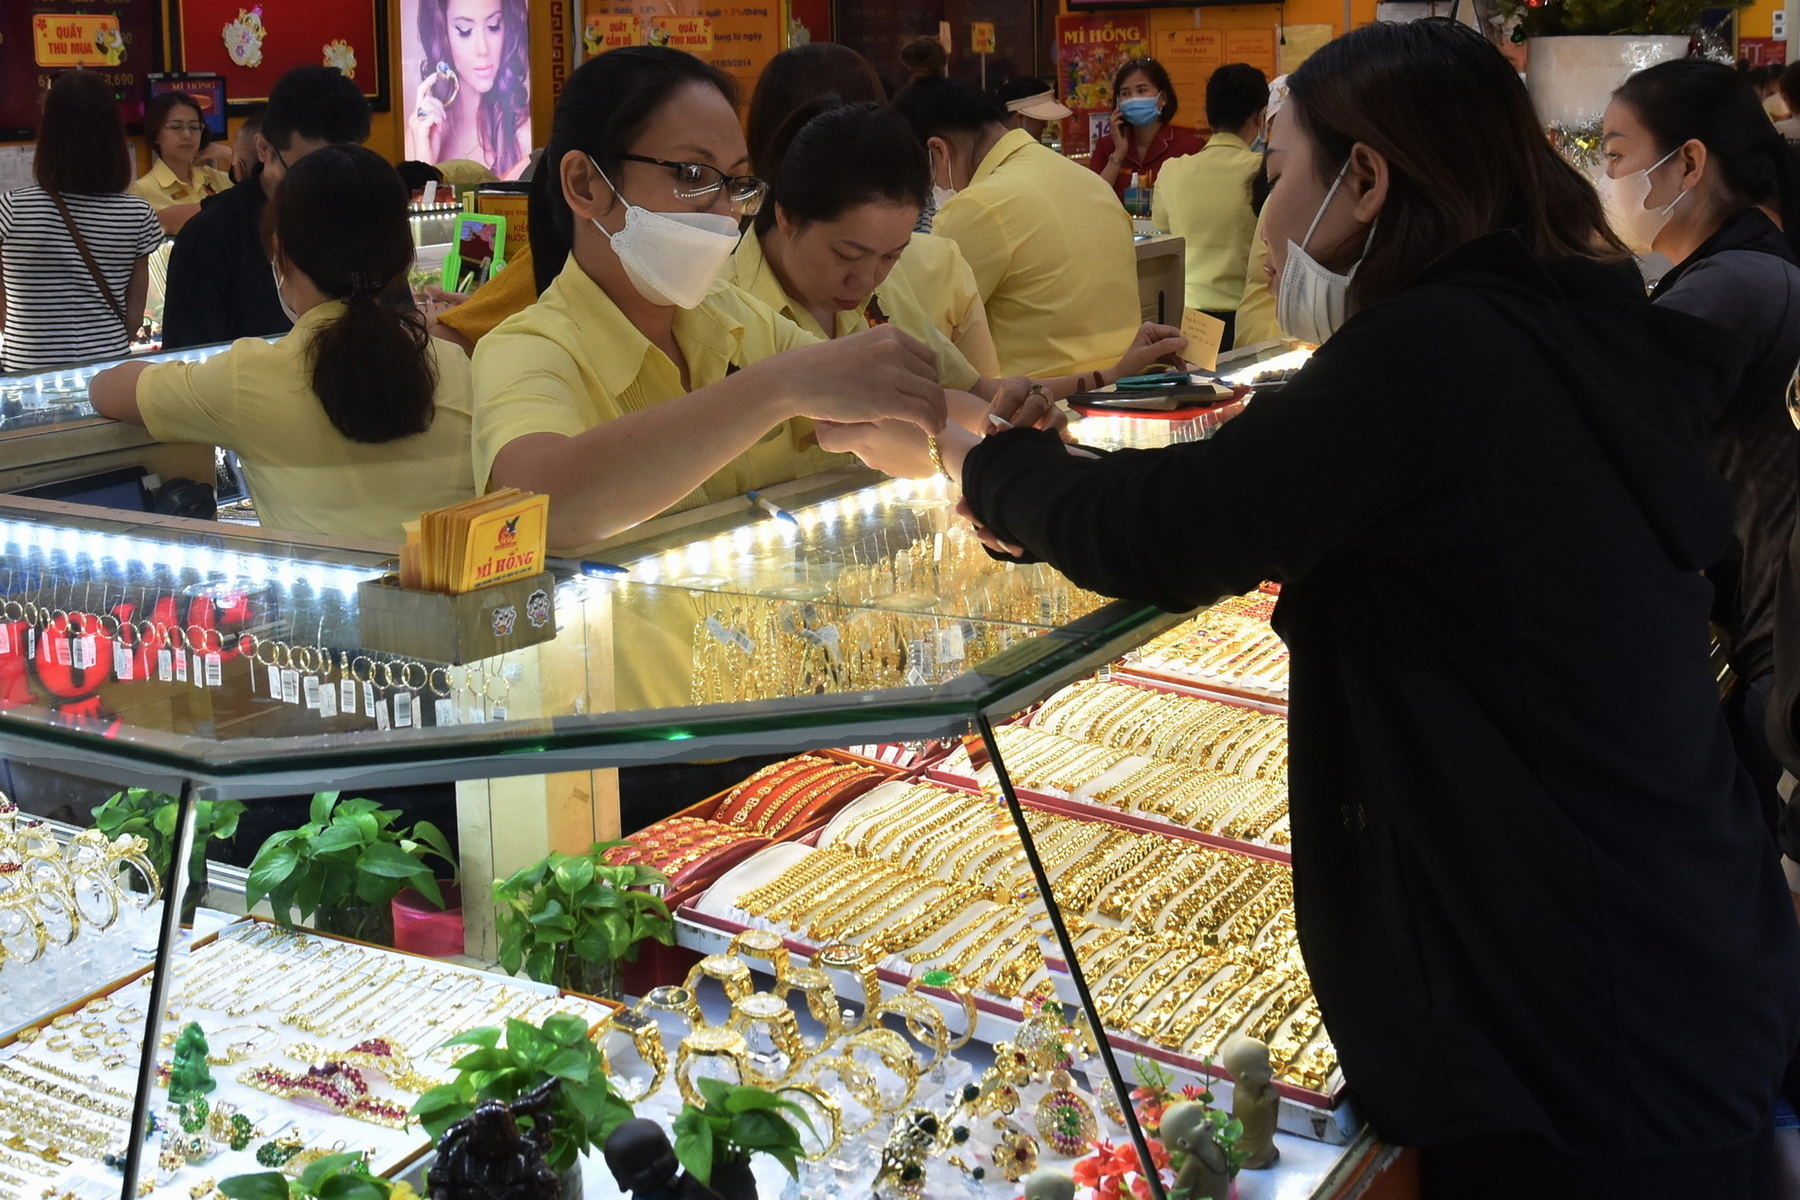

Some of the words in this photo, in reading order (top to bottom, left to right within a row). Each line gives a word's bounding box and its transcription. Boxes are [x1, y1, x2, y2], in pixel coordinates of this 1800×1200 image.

[1089, 21, 1140, 43] HỒNG
[670, 36, 684, 46] THU
[48, 42, 67, 55] THU
[70, 42, 93, 55] MUA
[506, 232, 526, 242] RƯỚC
[495, 547, 534, 574] HỒNG
